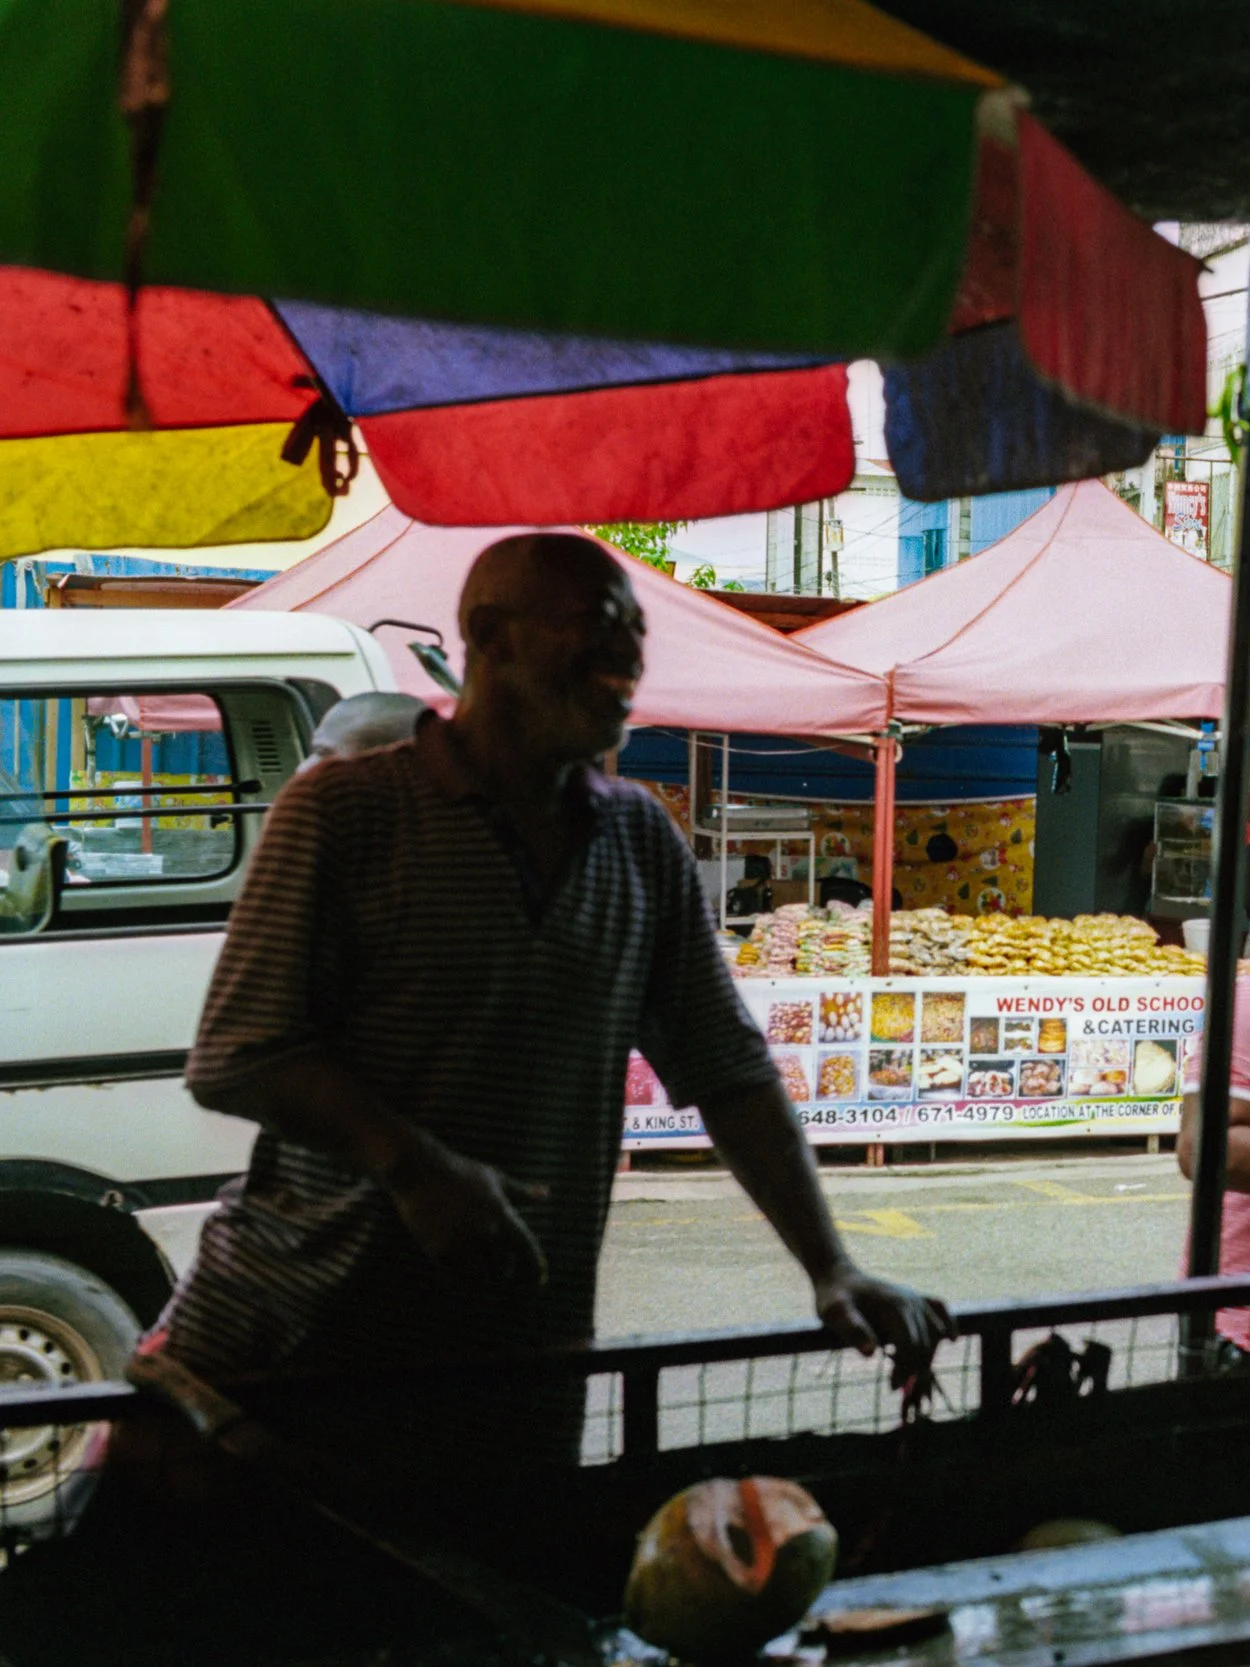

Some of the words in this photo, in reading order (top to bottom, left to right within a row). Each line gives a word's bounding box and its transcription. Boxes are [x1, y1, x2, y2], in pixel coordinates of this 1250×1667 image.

[997, 997, 1084, 1012] WENDY'S
[1092, 996, 1129, 1011] OLD
[1083, 1018, 1194, 1034] &CATERING
[917, 1106, 1014, 1122] 671-4979
[1023, 1106, 1074, 1120] LOCATION
[1079, 1105, 1091, 1117] AT
[1095, 1105, 1114, 1117] THE
[1118, 1104, 1158, 1116] CORNER
[1162, 1103, 1174, 1115] OF
[632, 1117, 640, 1130] &
[645, 1116, 676, 1130] KING
